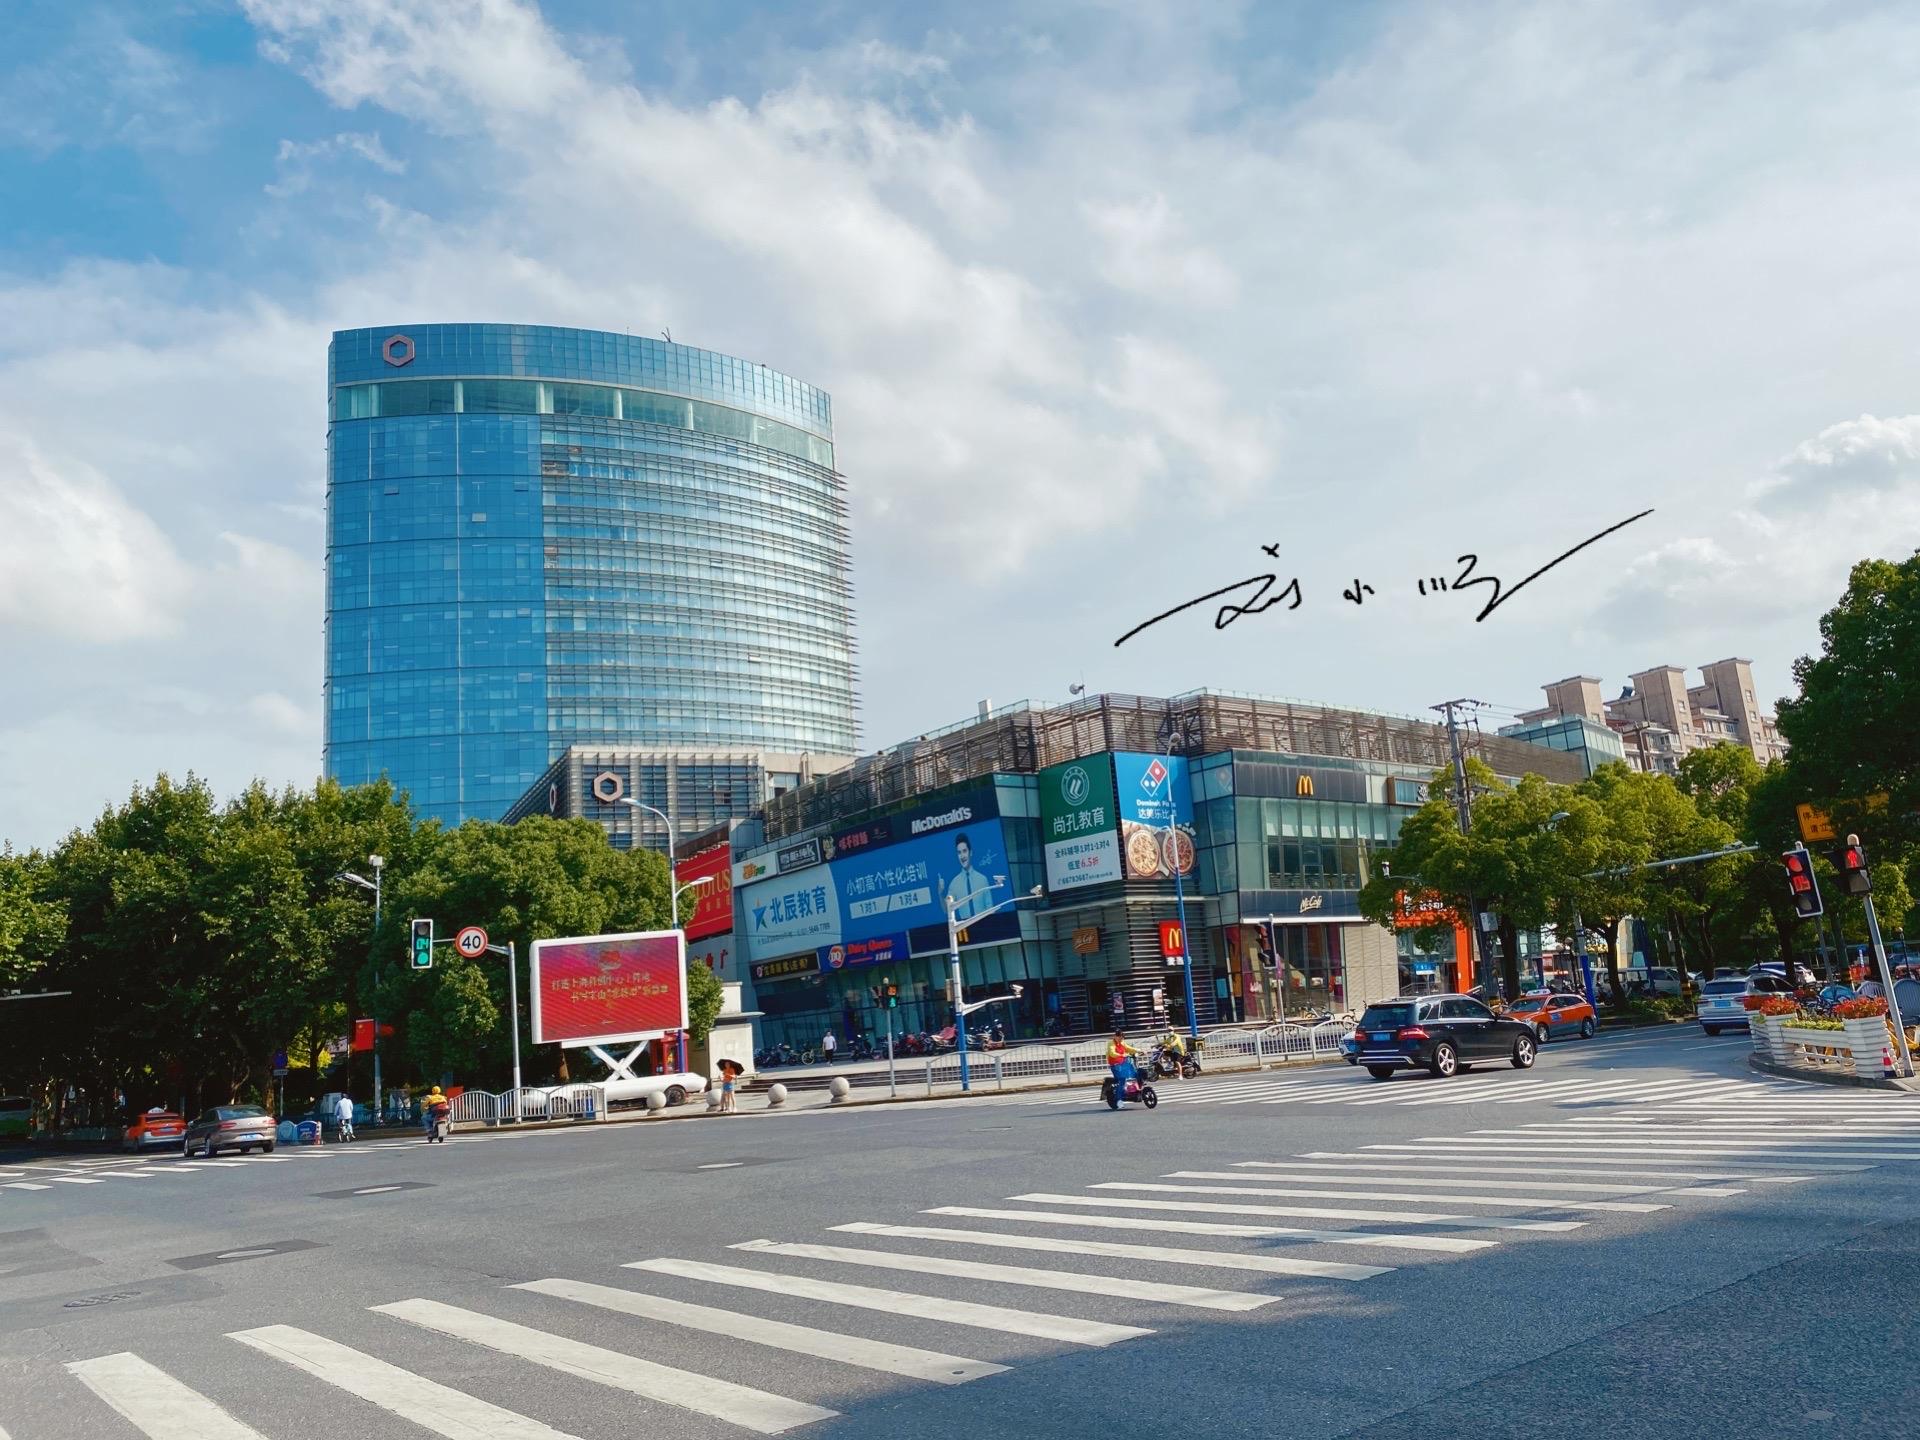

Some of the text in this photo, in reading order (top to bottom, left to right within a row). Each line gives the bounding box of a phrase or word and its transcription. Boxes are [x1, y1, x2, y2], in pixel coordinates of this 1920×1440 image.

[1136, 799, 1161, 807] Domino's
[911, 807, 972, 834] McDonald's
[1053, 807, 1105, 836] 尚孔教育
[846, 861, 928, 896] 小初高个性化培训
[770, 886, 827, 925] 北辰教育
[859, 892, 918, 914] 1对1 1对4
[462, 935, 481, 949] 40
[831, 951, 841, 961] DQ
